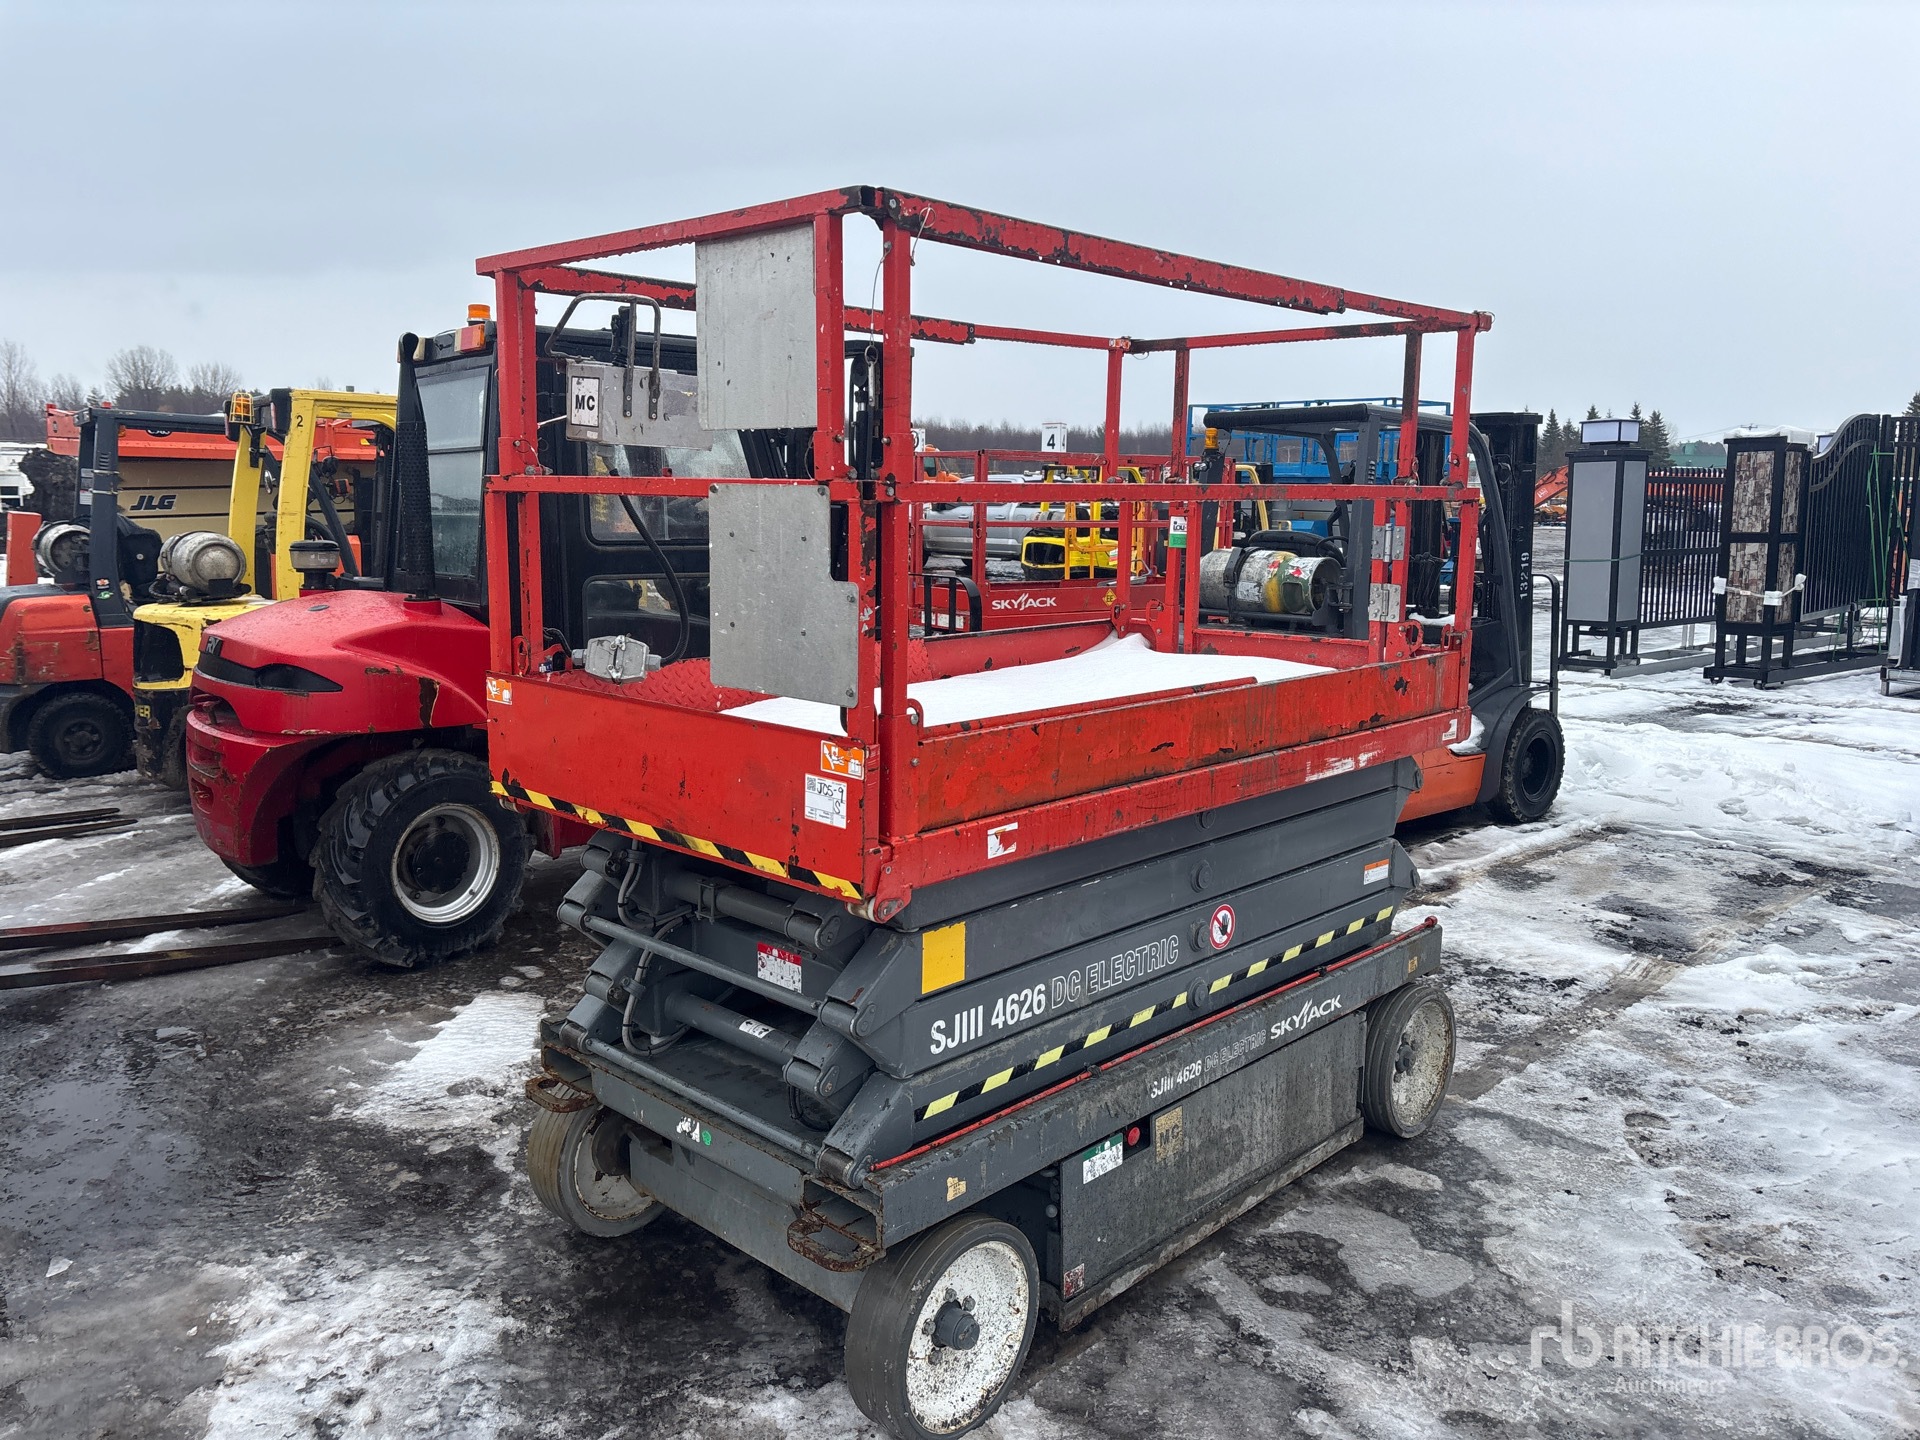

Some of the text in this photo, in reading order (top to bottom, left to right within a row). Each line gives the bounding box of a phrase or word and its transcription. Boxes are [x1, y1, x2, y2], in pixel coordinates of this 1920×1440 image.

[575, 394, 595, 411] MC
[297, 415, 304, 428] 2
[1046, 433, 1056, 450] 4
[129, 494, 177, 511] JLG
[1520, 552, 1530, 600] 13219
[991, 593, 1058, 611] SKYJACK
[930, 934, 1179, 1055] SJIII 4626 DC ELECTRIC
[1176, 1060, 1202, 1085] 4626
[1204, 1052, 1219, 1072] DC
[1219, 1029, 1267, 1066] ELECTRIC
[1270, 994, 1342, 1040] SKYJACK
[1160, 1124, 1180, 1145] MC
